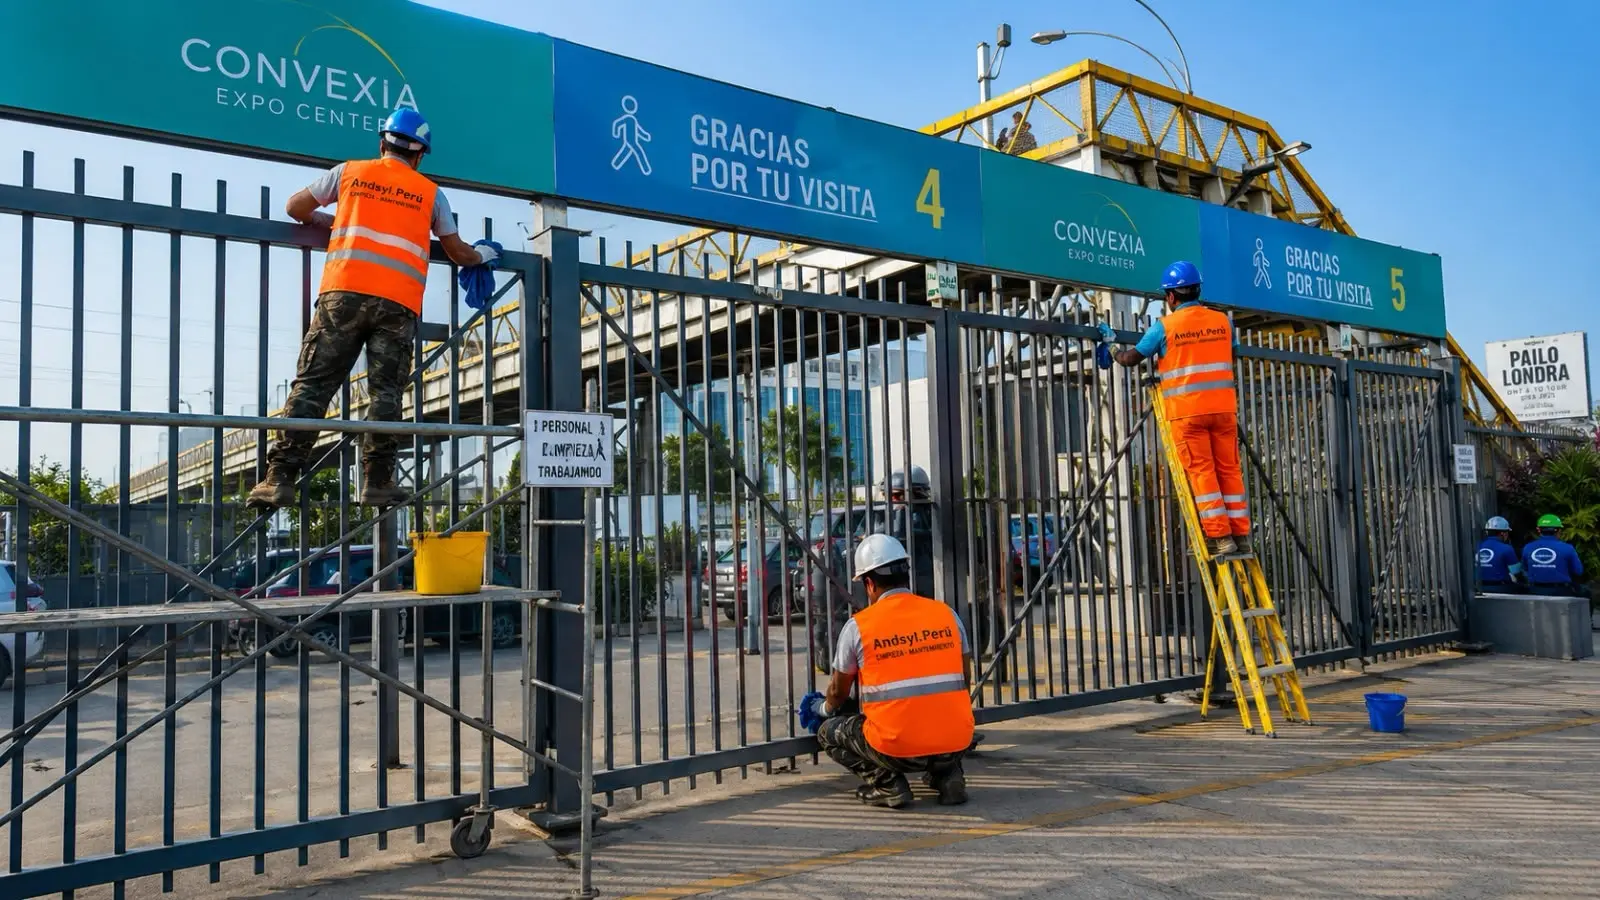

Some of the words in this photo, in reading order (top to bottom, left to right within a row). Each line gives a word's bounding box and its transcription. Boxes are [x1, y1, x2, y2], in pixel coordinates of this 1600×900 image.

[180, 37, 419, 114] CONVEXIA
[216, 86, 285, 115] EXPO
[690, 113, 810, 169] GRACIAS
[691, 152, 749, 195] POR
[756, 165, 790, 202] TU
[799, 175, 877, 218] VISITA
[915, 167, 945, 230] 4
[1054, 219, 1146, 257] CONVEXIA
[1068, 248, 1095, 263] EXPO
[1098, 254, 1135, 270] CENTER
[1285, 245, 1340, 276] GRACIAS
[1287, 271, 1313, 297] POR
[1315, 276, 1332, 300] TU
[1335, 280, 1374, 307] VISITA
[1390, 267, 1406, 312] 5
[1502, 363, 1571, 387] LONDRA
[1509, 346, 1559, 368] PAILO
[541, 419, 593, 435] PERSONAL
